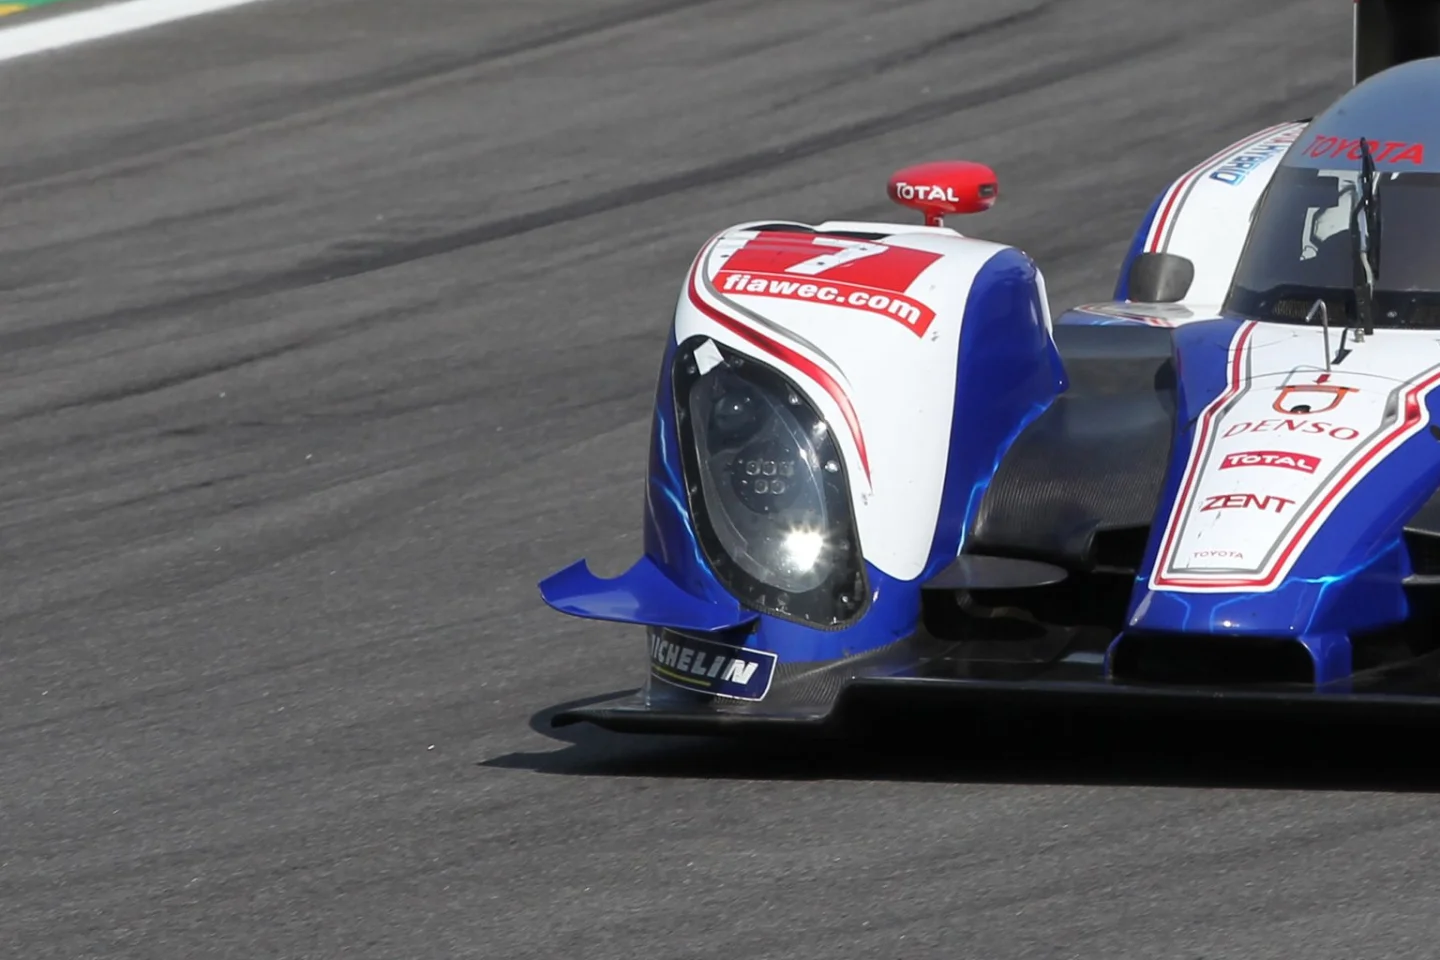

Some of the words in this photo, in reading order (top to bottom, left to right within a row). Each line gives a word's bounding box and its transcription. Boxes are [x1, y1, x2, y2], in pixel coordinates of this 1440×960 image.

[1301, 134, 1425, 165] TOYOTA
[896, 182, 960, 203] TOTAL
[784, 237, 889, 275] 7
[722, 274, 922, 325] fiawec.com
[1222, 419, 1360, 440] DENSO
[1228, 454, 1313, 471] TOTAL
[1200, 494, 1296, 514] ZENT
[1193, 550, 1244, 560] TOYOTA
